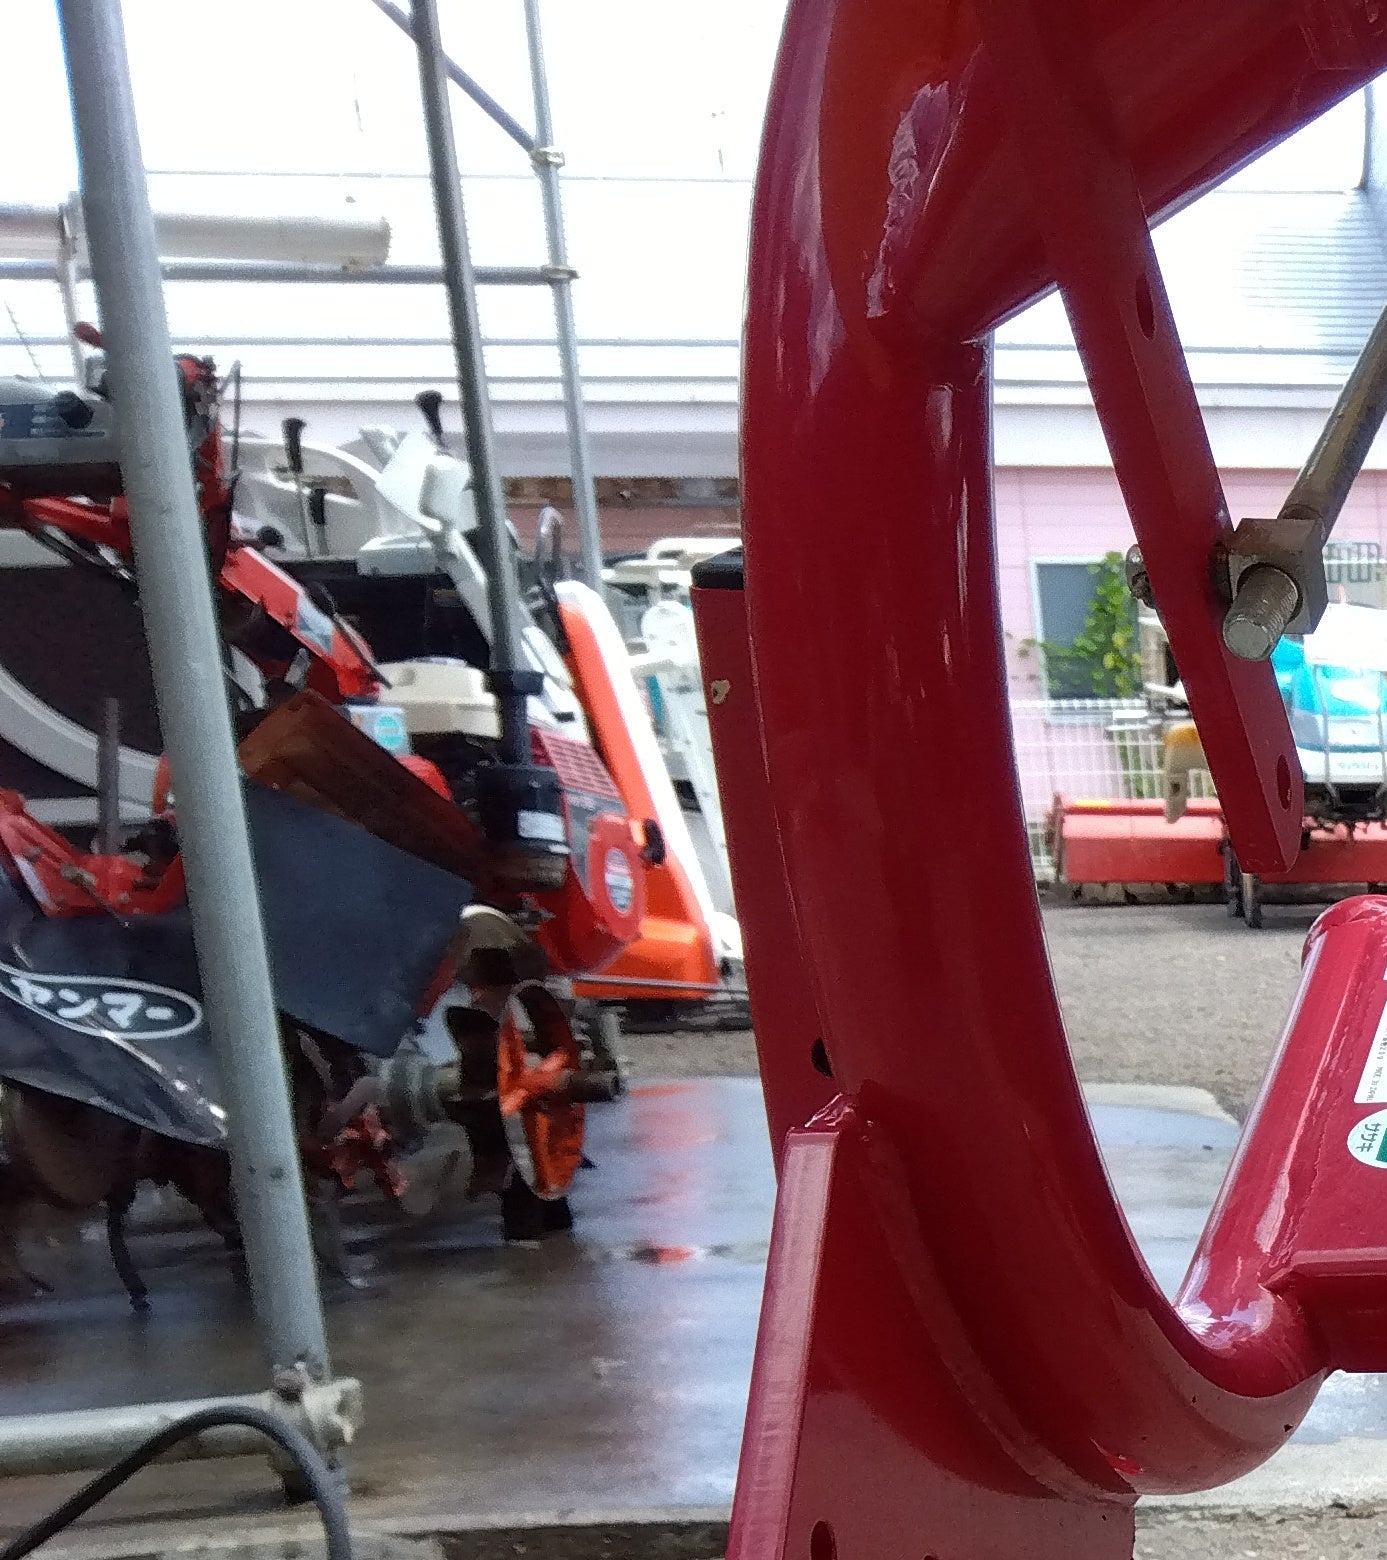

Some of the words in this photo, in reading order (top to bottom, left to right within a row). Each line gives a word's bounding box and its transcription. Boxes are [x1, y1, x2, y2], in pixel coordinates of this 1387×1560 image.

[11, 976, 174, 1029] ヤンマー
[1356, 1122, 1382, 1153] ササキ
